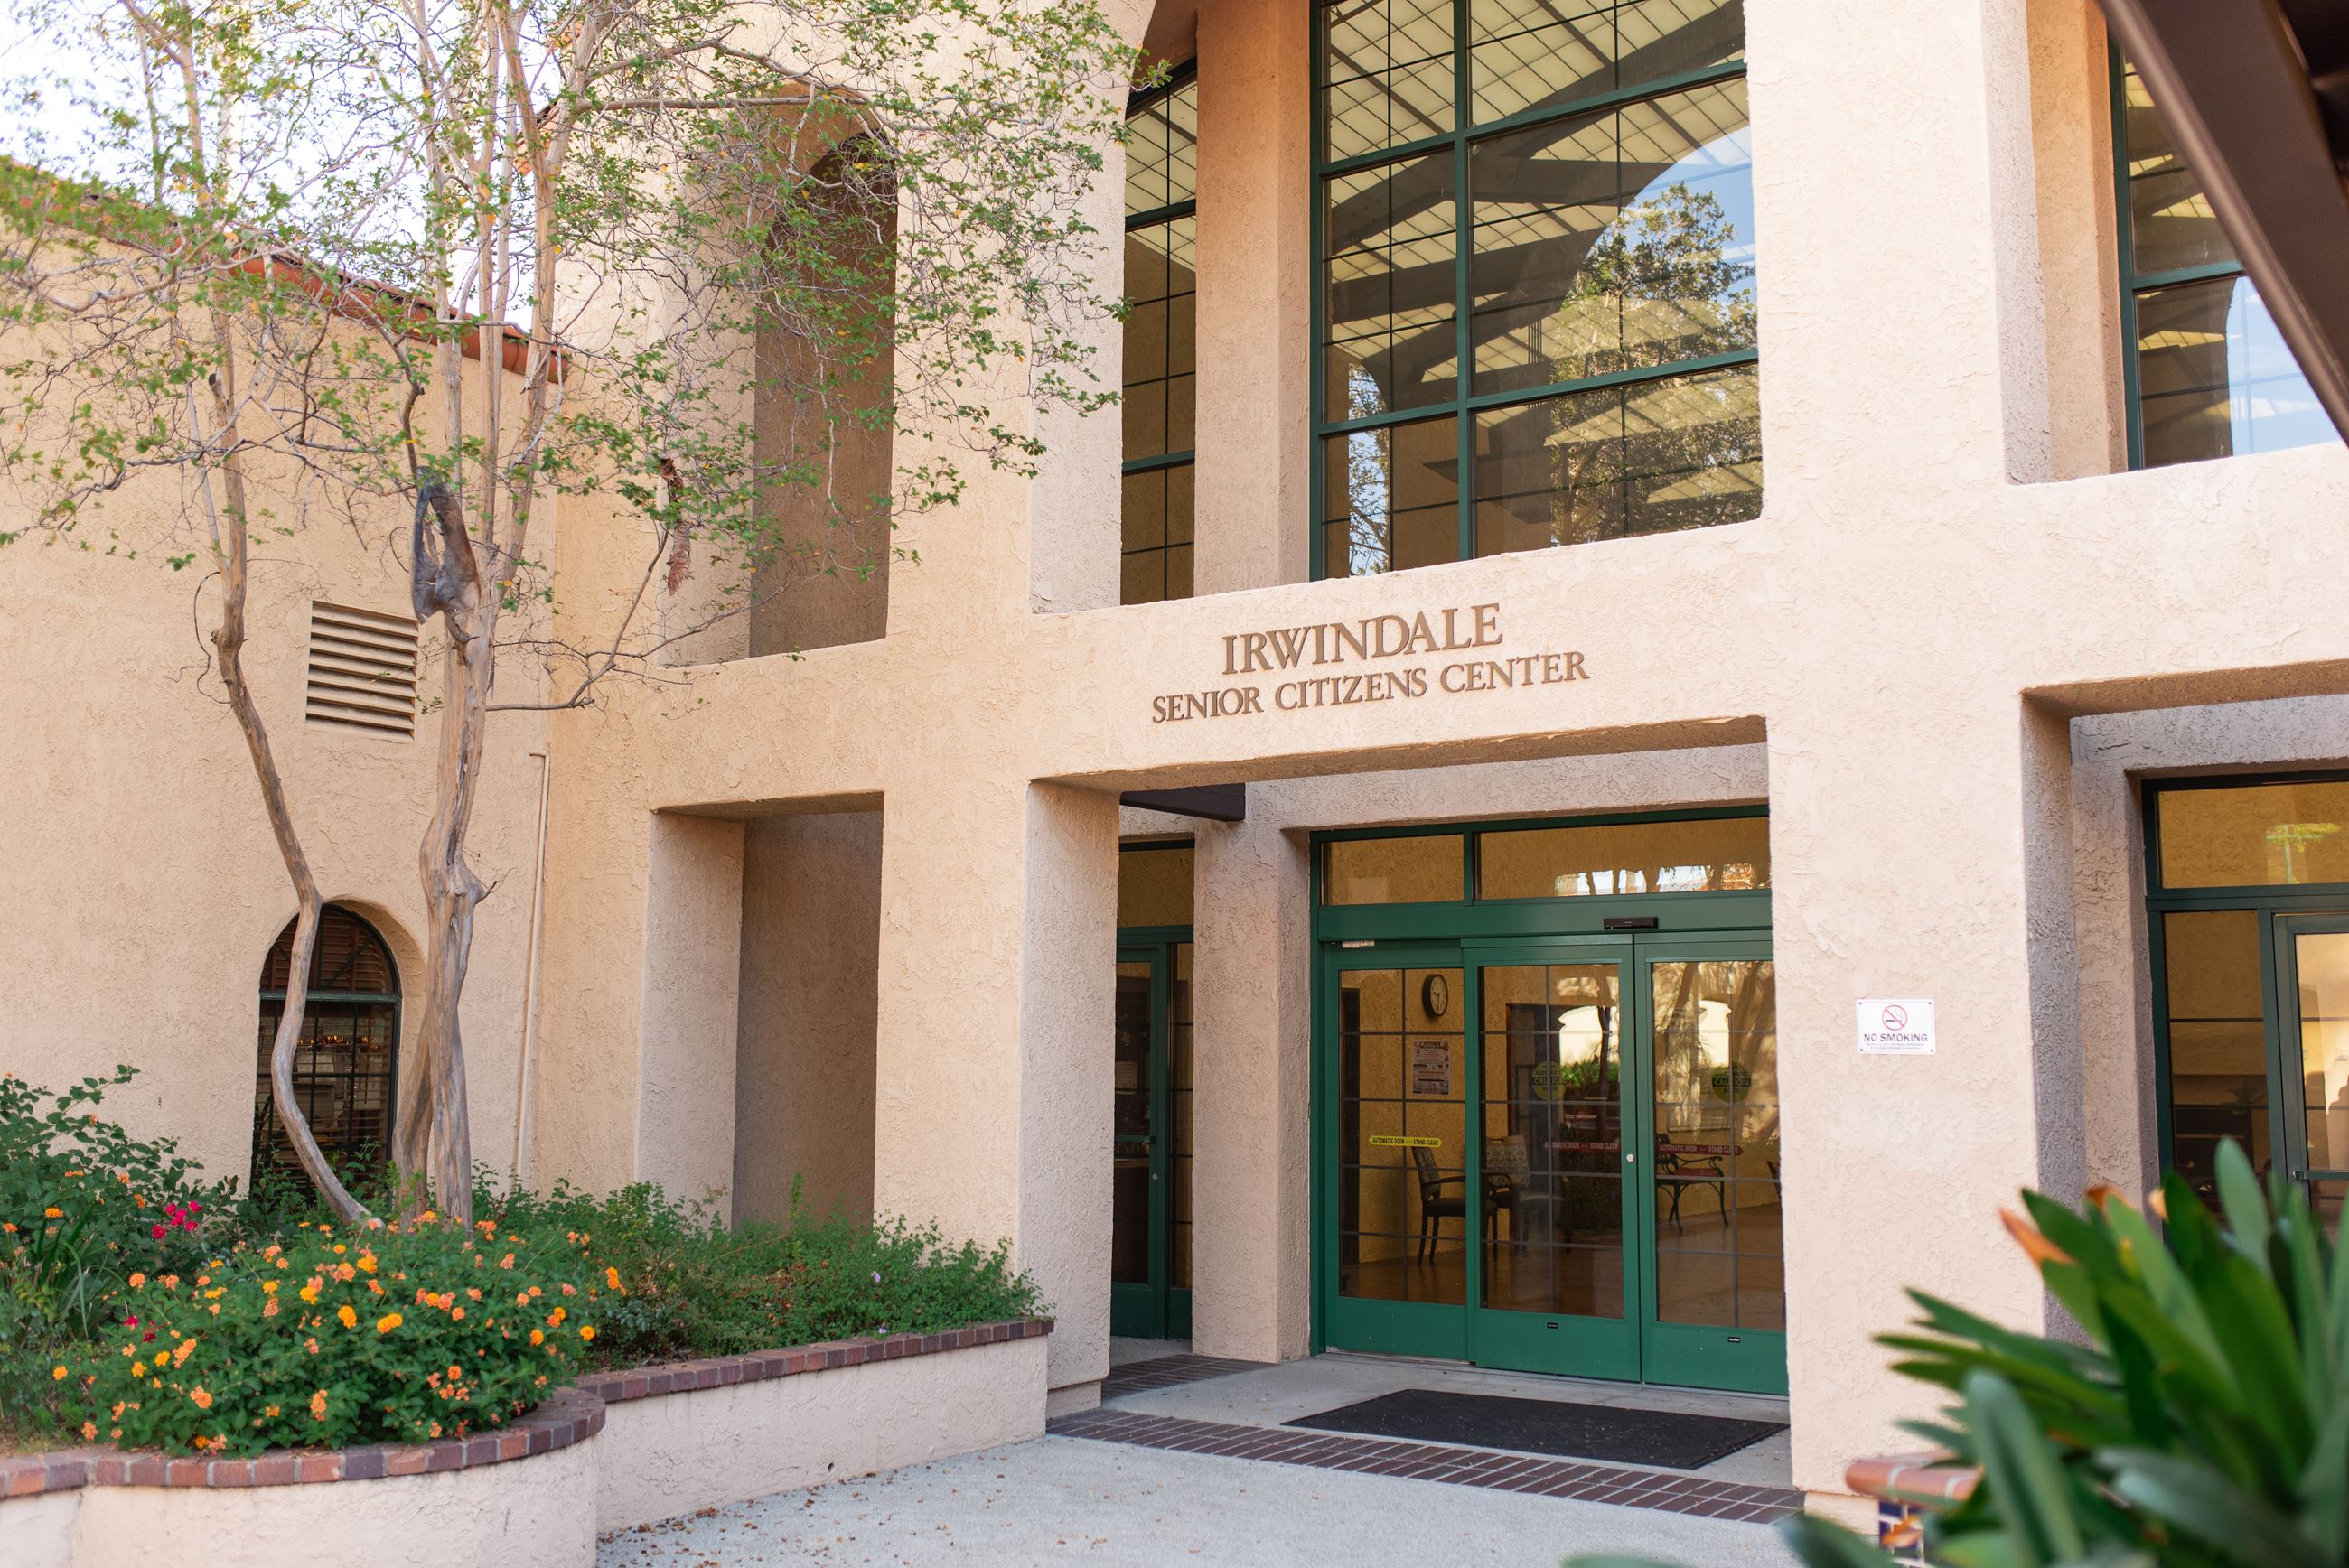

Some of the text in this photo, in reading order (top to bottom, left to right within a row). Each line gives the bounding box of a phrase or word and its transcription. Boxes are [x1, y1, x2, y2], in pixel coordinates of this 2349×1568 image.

[1221, 602, 1504, 675] IRWINDALE
[1152, 650, 1590, 723] SENIOR CITIZENS CENTER
[1864, 1033, 1928, 1041] NO SMOKING
[1533, 1077, 1565, 1085] CAUION
[1568, 1141, 1580, 1149] DOOR
[1604, 1142, 1618, 1150] CLEAR
[1659, 1143, 1685, 1152] AUTOMATIC
[1708, 1145, 1723, 1153] STAND
